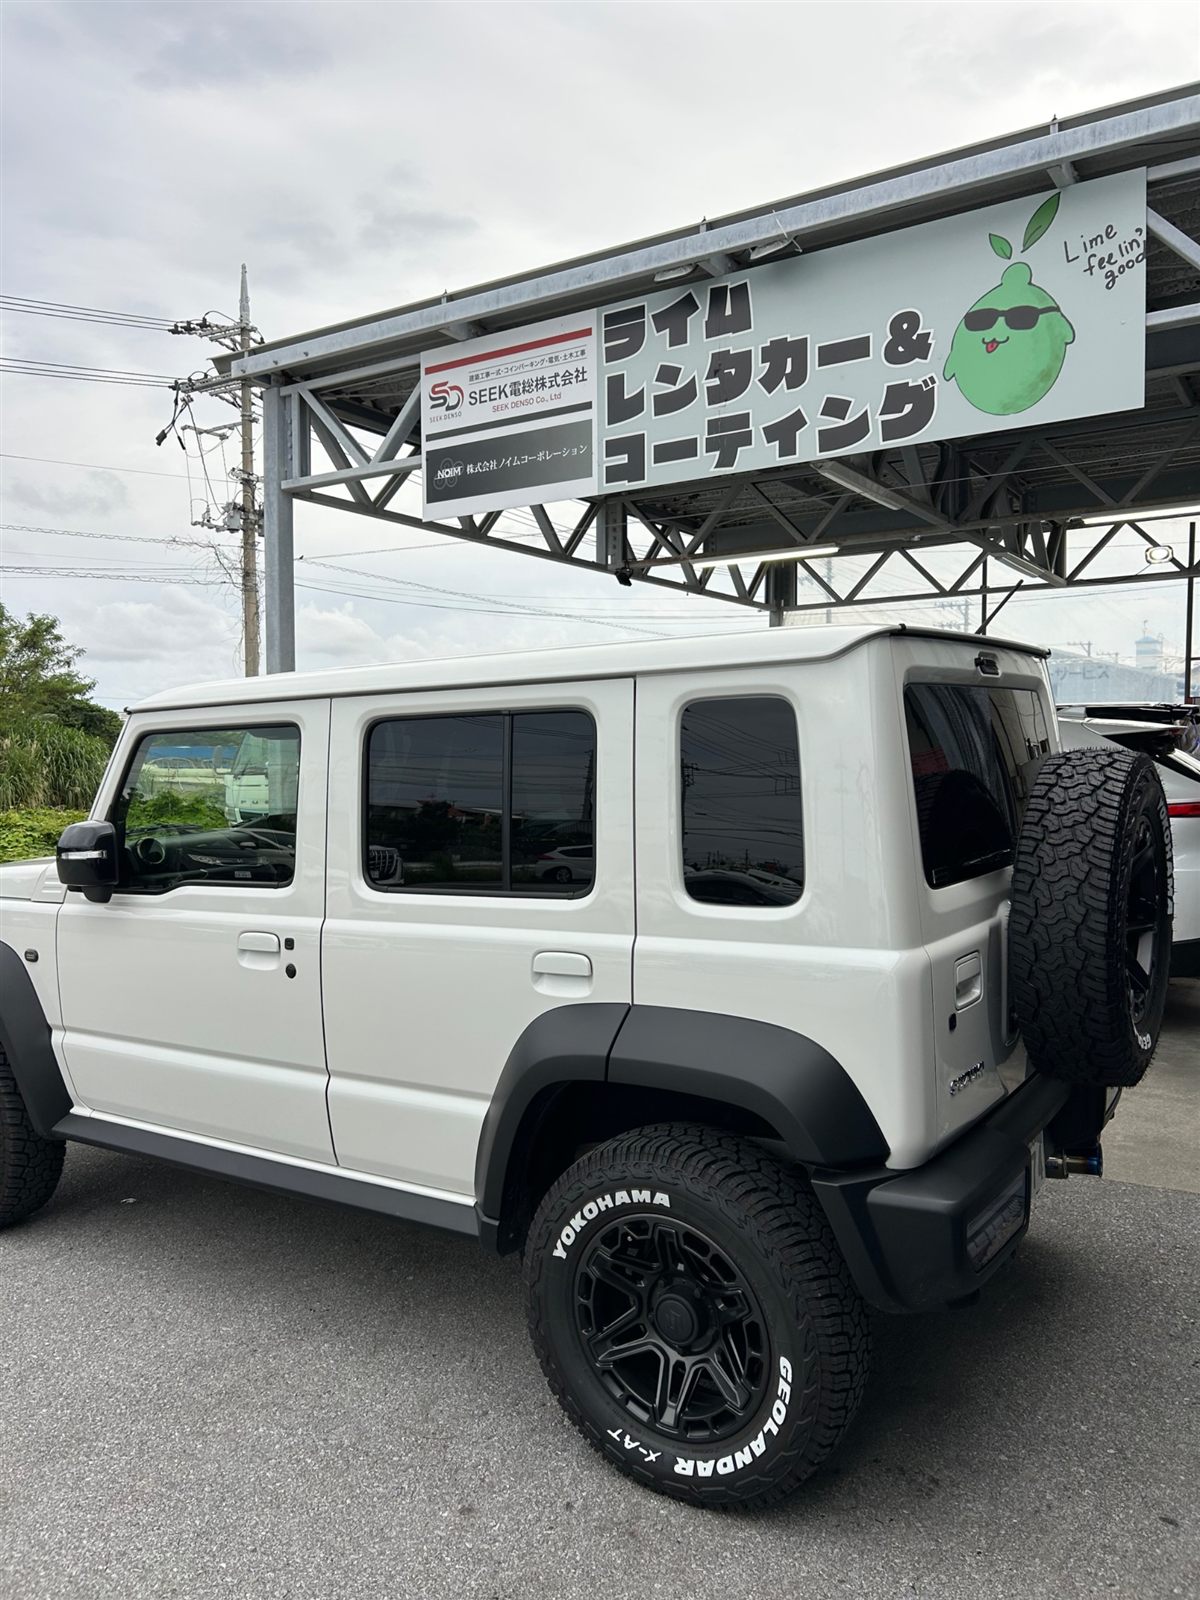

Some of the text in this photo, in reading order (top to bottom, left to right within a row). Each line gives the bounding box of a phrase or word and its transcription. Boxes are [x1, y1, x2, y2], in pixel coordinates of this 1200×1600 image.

[1063, 223, 1118, 264] Lime
[603, 280, 752, 364] ライム
[443, 411, 463, 420] DENSO
[492, 402, 510, 413] SEEK
[510, 397, 535, 409] DENSO
[604, 375, 936, 485] コーティング
[466, 460, 498, 475] 株式会社
[1051, 663, 1110, 680] サービス
[552, 1189, 671, 1260] YOKOHAMA
[606, 1355, 793, 1478] GEOLANDAR X-AT
